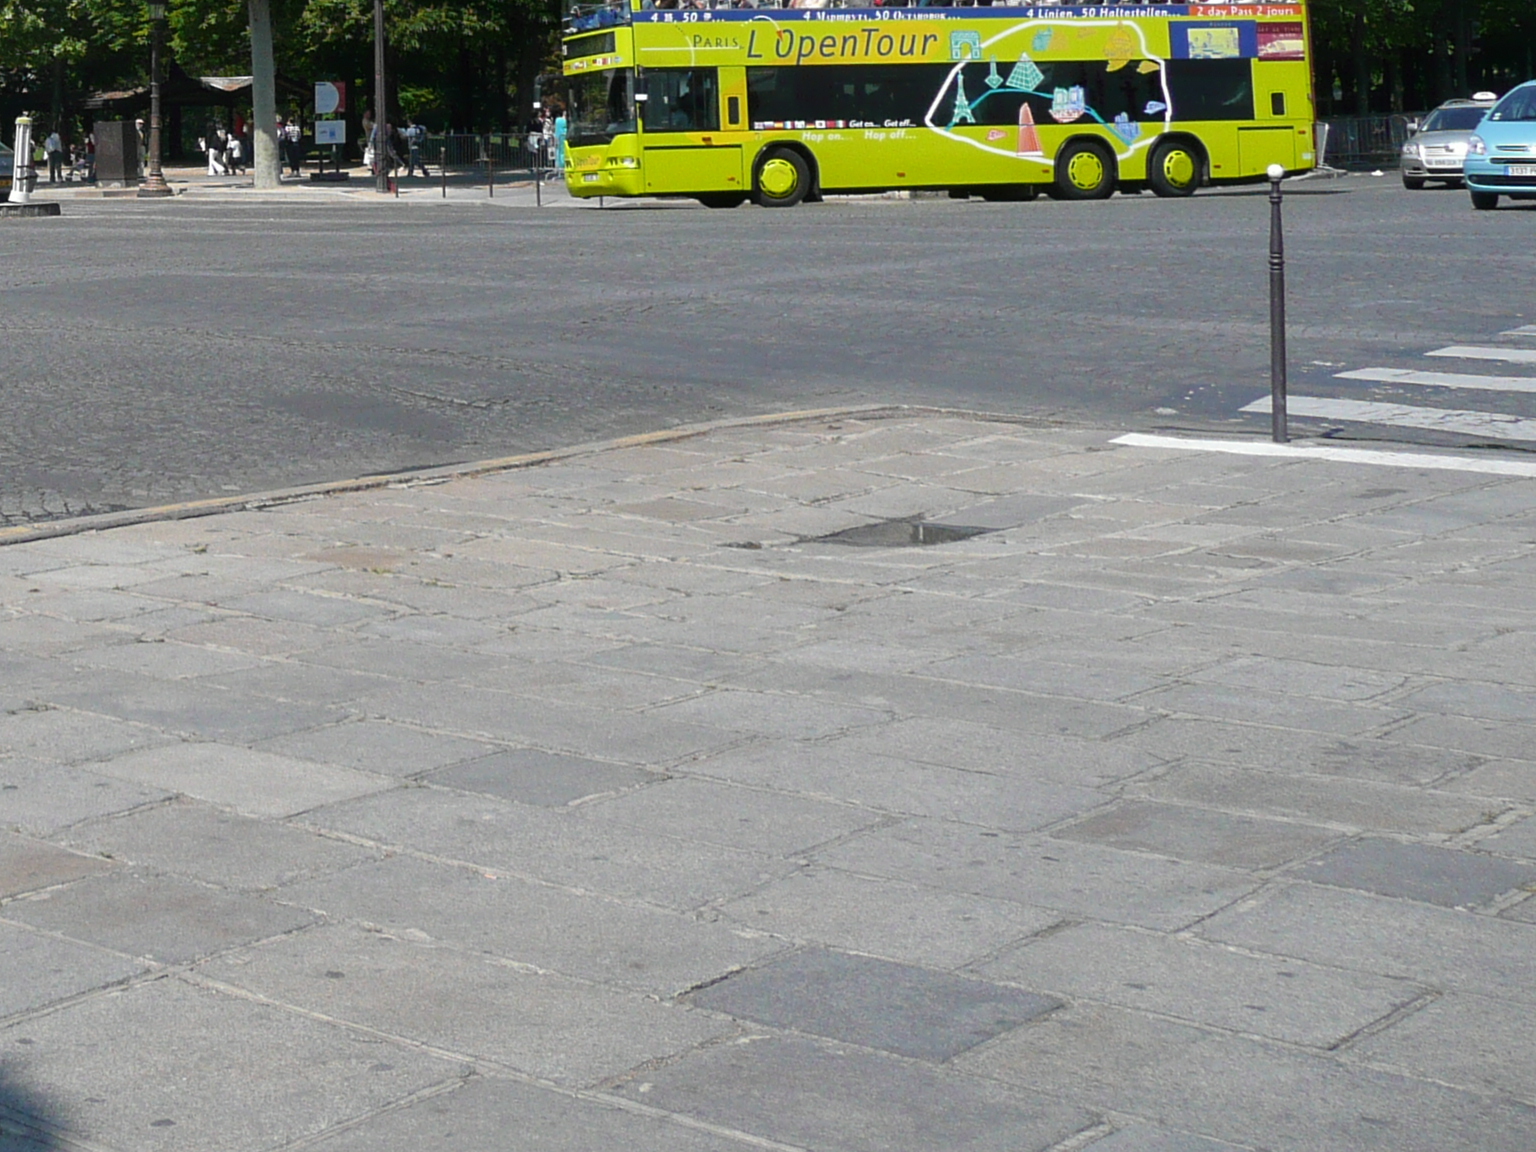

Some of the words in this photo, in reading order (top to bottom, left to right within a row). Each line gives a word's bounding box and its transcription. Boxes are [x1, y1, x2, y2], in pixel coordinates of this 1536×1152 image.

[651, 12, 659, 23] 4
[682, 12, 699, 23] 50
[803, 10, 811, 21] 4
[875, 10, 890, 21] 50
[1026, 8, 1034, 19] 4
[1082, 7, 1096, 18] 50
[1196, 5, 1204, 17] 2
[1207, 5, 1228, 18] day
[1230, 5, 1253, 17] Pass
[1256, 5, 1263, 16] 2
[1266, 5, 1295, 18] jours
[802, 131, 824, 142] Hop
[864, 128, 886, 142] Hop
